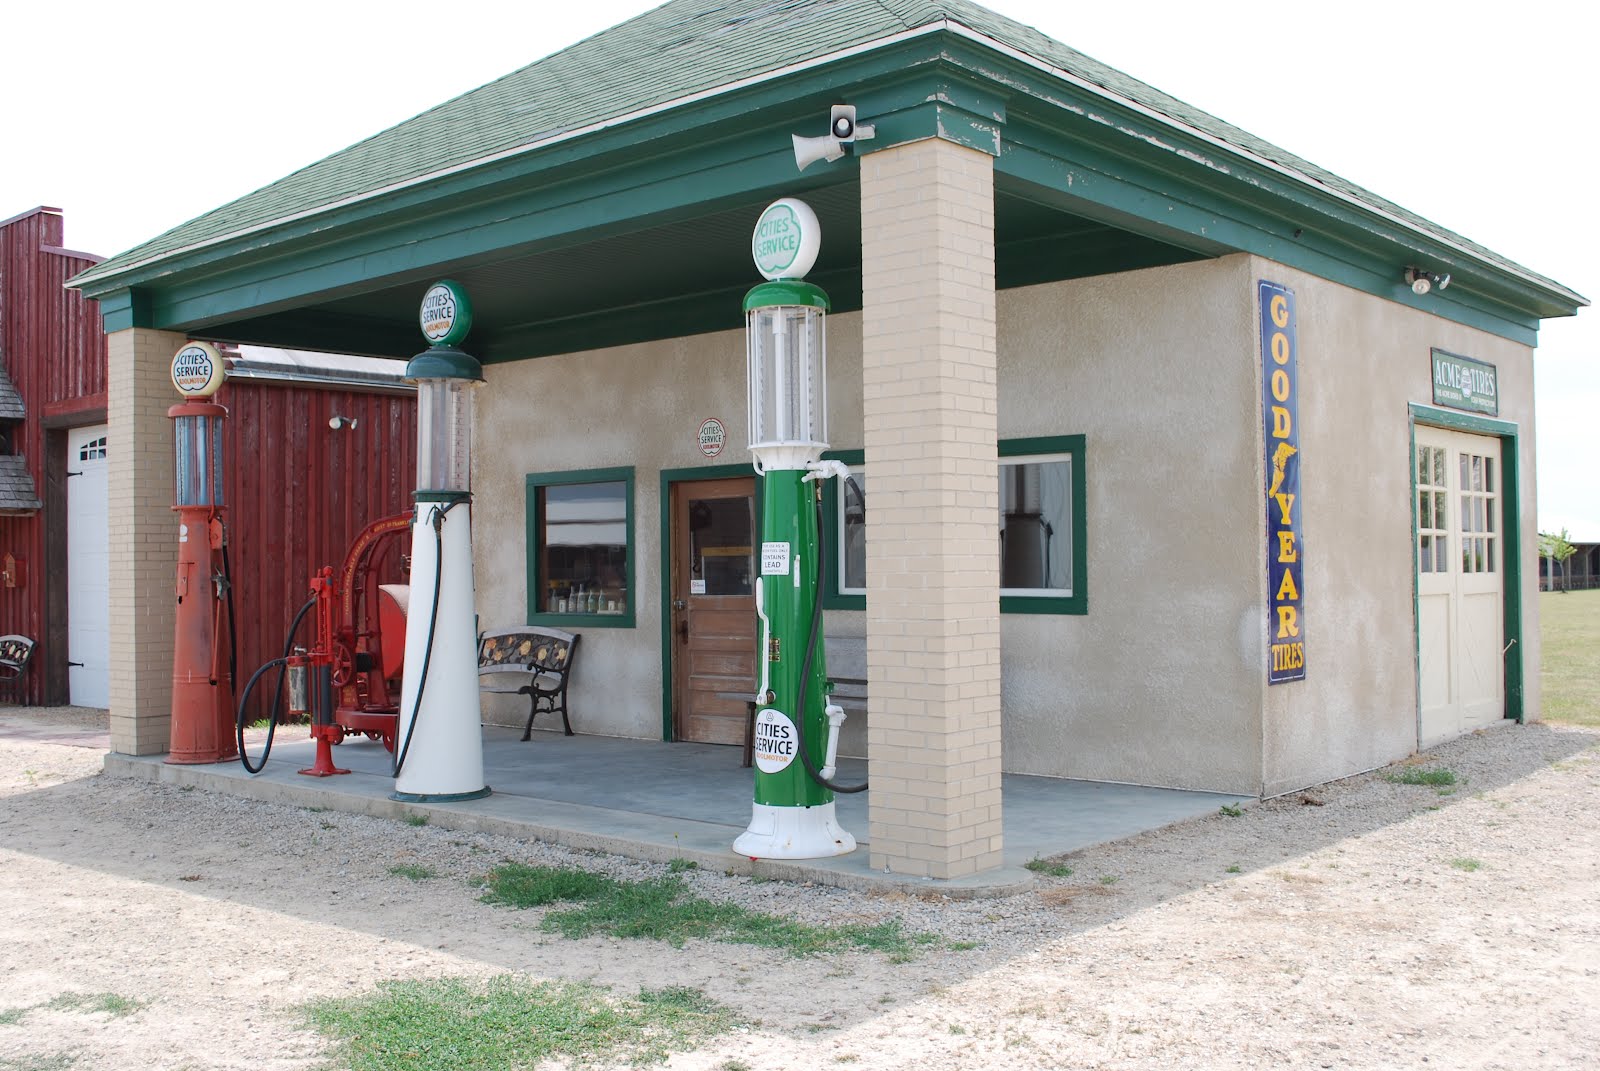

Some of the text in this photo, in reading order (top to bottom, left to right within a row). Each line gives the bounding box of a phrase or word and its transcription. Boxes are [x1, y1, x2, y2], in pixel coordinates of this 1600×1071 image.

[760, 217, 789, 238] CITIES
[757, 234, 795, 258] SERVICE
[425, 293, 448, 309] CITIES
[423, 306, 452, 323] SERVICE
[180, 354, 205, 365] CITIES
[176, 365, 209, 377] SERVICE
[1435, 359, 1461, 389] ACME
[1470, 368, 1494, 397] TIRES
[701, 435, 721, 443] SERVICE
[703, 426, 719, 435] CITIES
[1270, 294, 1299, 639] GOODYEAR
[1272, 642, 1304, 671] TIRES
[757, 722, 789, 738] CITIES
[755, 737, 792, 755] SERVICE
